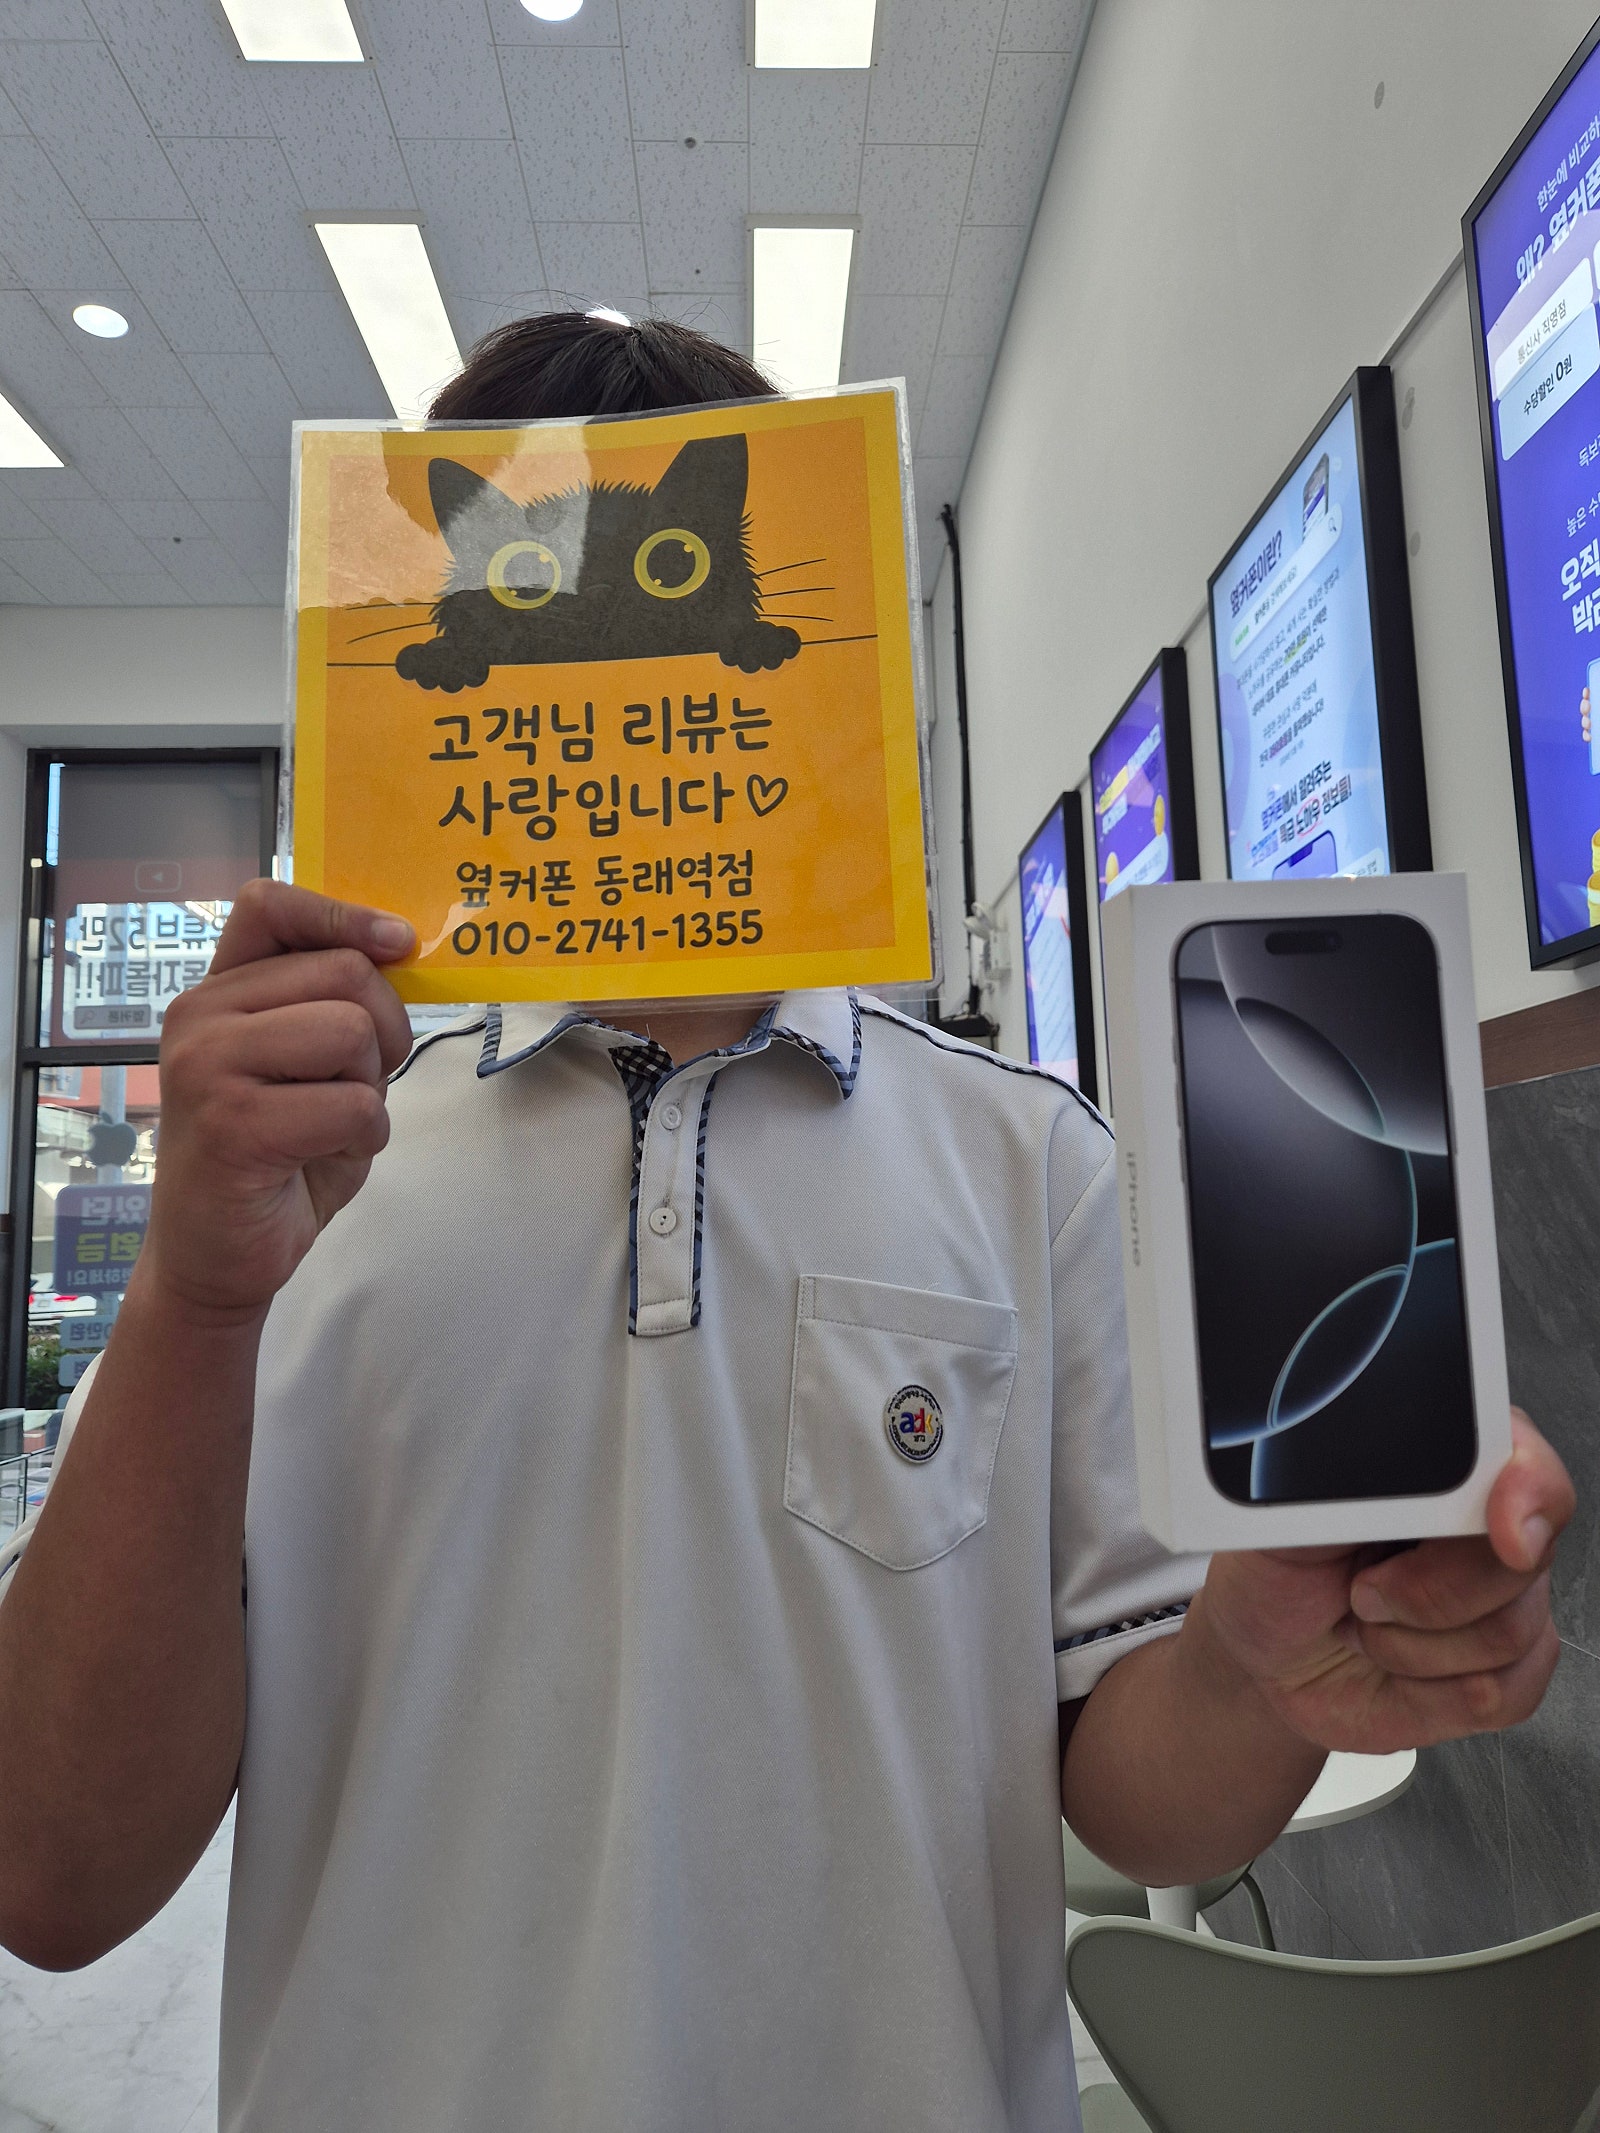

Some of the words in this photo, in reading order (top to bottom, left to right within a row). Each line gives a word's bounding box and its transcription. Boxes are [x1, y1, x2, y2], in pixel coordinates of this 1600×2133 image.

[1537, 158, 1568, 213] 한눈에
[1516, 233, 1545, 293] 왜?
[1517, 328, 1541, 365] 통신사
[1542, 299, 1567, 333] 직영점
[1523, 372, 1555, 416] 수당할인
[1555, 354, 1573, 382] 0원
[1578, 433, 1600, 467] 독보
[1567, 506, 1587, 538] 높은
[1230, 529, 1282, 619] 옆커폰이란?
[1561, 538, 1600, 601] 오직
[429, 701, 595, 765] 고객님
[623, 692, 773, 755] 리뷰는
[438, 771, 736, 841] 사랑입니다
[1298, 760, 1332, 801] 알려주는
[456, 860, 576, 909] 옆커폰
[594, 849, 754, 907] 동래역점
[452, 908, 764, 956] 010-2741-1355
[1126, 1151, 1142, 1267] iPhone
